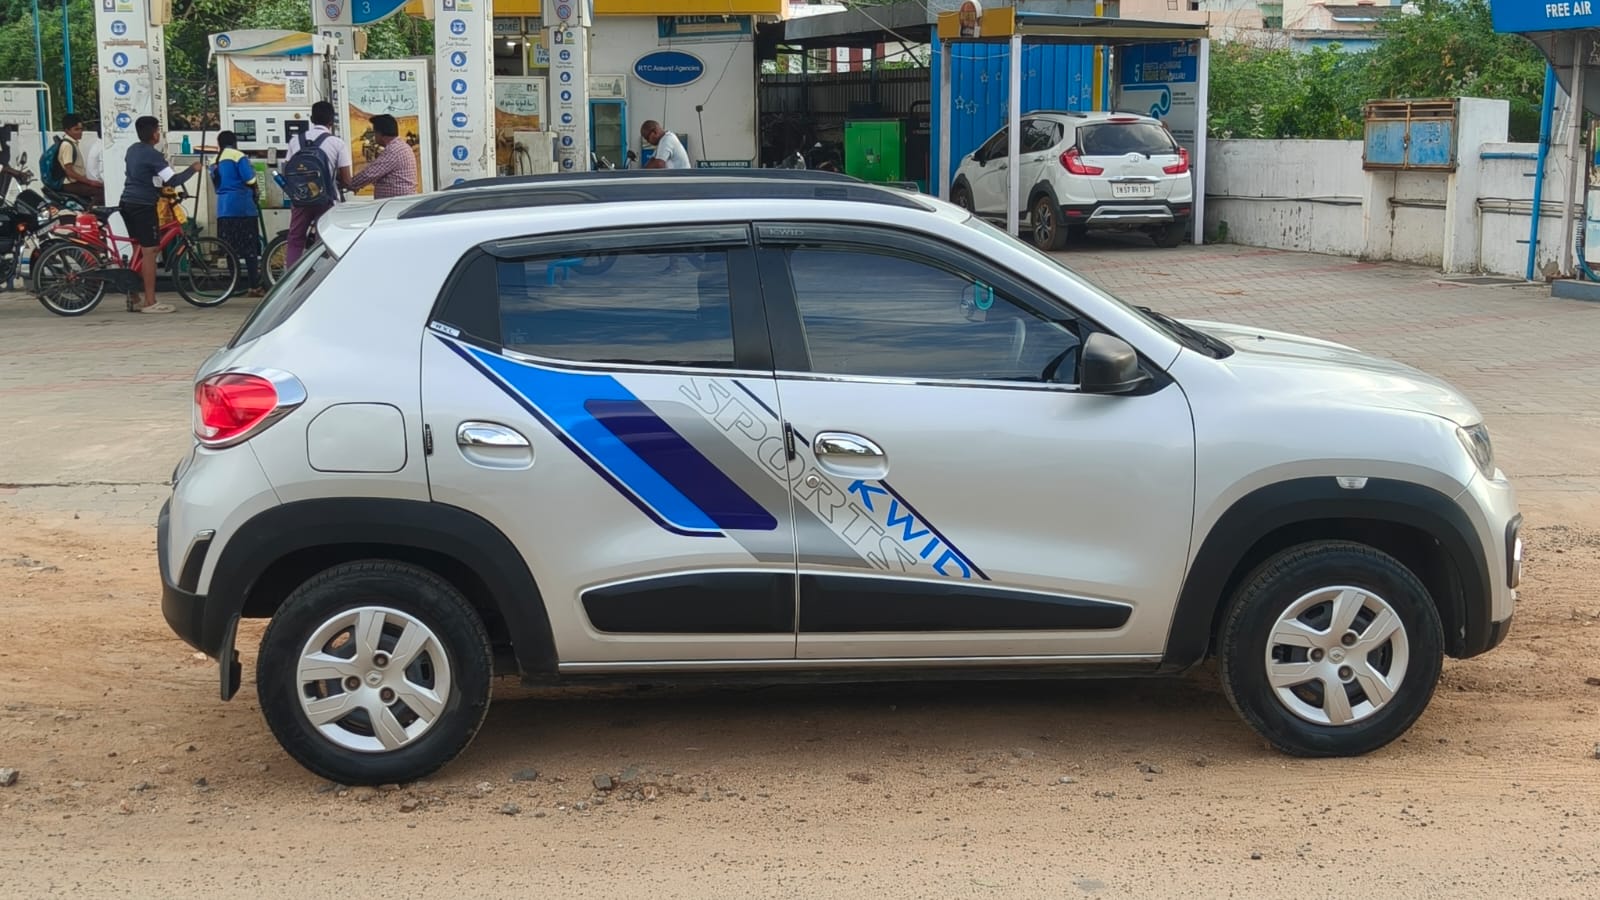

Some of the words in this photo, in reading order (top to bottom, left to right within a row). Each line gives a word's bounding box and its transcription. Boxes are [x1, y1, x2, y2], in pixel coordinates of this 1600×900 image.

[362, 1, 371, 14] 3
[1546, 2, 1570, 18] FREE
[1573, 1, 1593, 16] AIR
[769, 228, 804, 236] KWID
[679, 377, 918, 573] SPORTS
[848, 479, 972, 579] KWID
